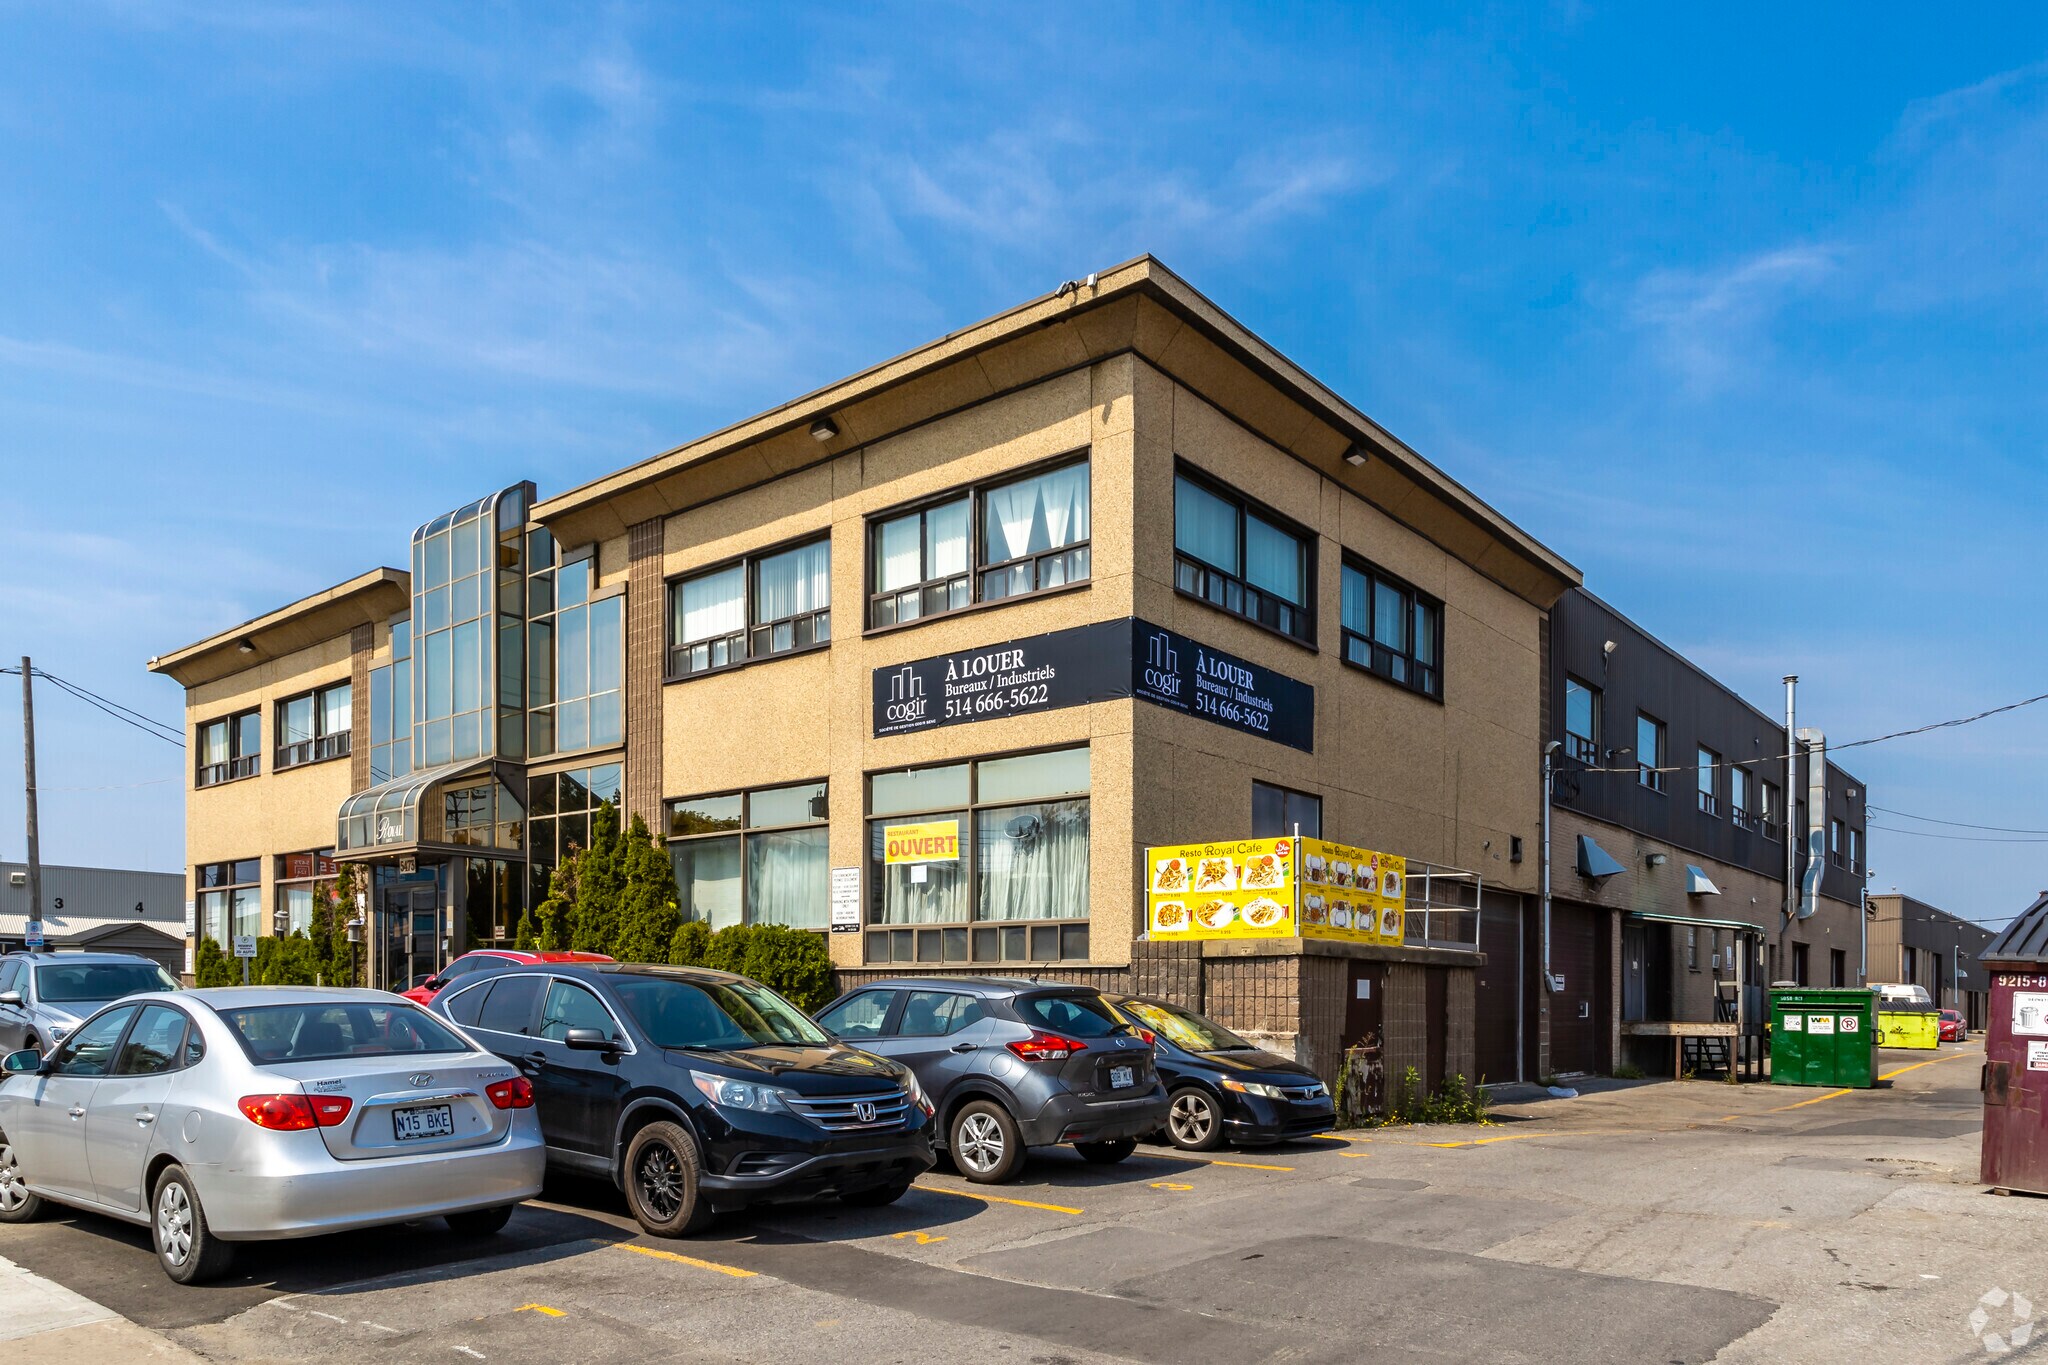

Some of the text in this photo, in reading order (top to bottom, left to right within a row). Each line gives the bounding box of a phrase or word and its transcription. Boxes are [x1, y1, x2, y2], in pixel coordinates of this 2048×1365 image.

[945, 649, 1025, 682] À LOUER
[1196, 649, 1254, 691] À LOUER
[945, 679, 987, 697] Bureaux
[997, 664, 1056, 688] Industriels
[1145, 669, 1181, 696] cogir
[945, 684, 1048, 718] 514 666-5622
[1196, 674, 1228, 698] Bureaux
[1235, 688, 1273, 712] Industriels
[887, 697, 927, 721] cogir
[1196, 692, 1269, 731] 514 666-5622
[887, 829, 919, 837] RESTAURANT
[888, 835, 957, 857] OUVERT
[1204, 845, 1235, 857] Royal
[1322, 845, 1334, 854] Resto
[1334, 846, 1349, 859] Royal
[54, 898, 64, 909] 3
[135, 901, 144, 912] 4
[397, 1112, 450, 1131] N15 BKE
